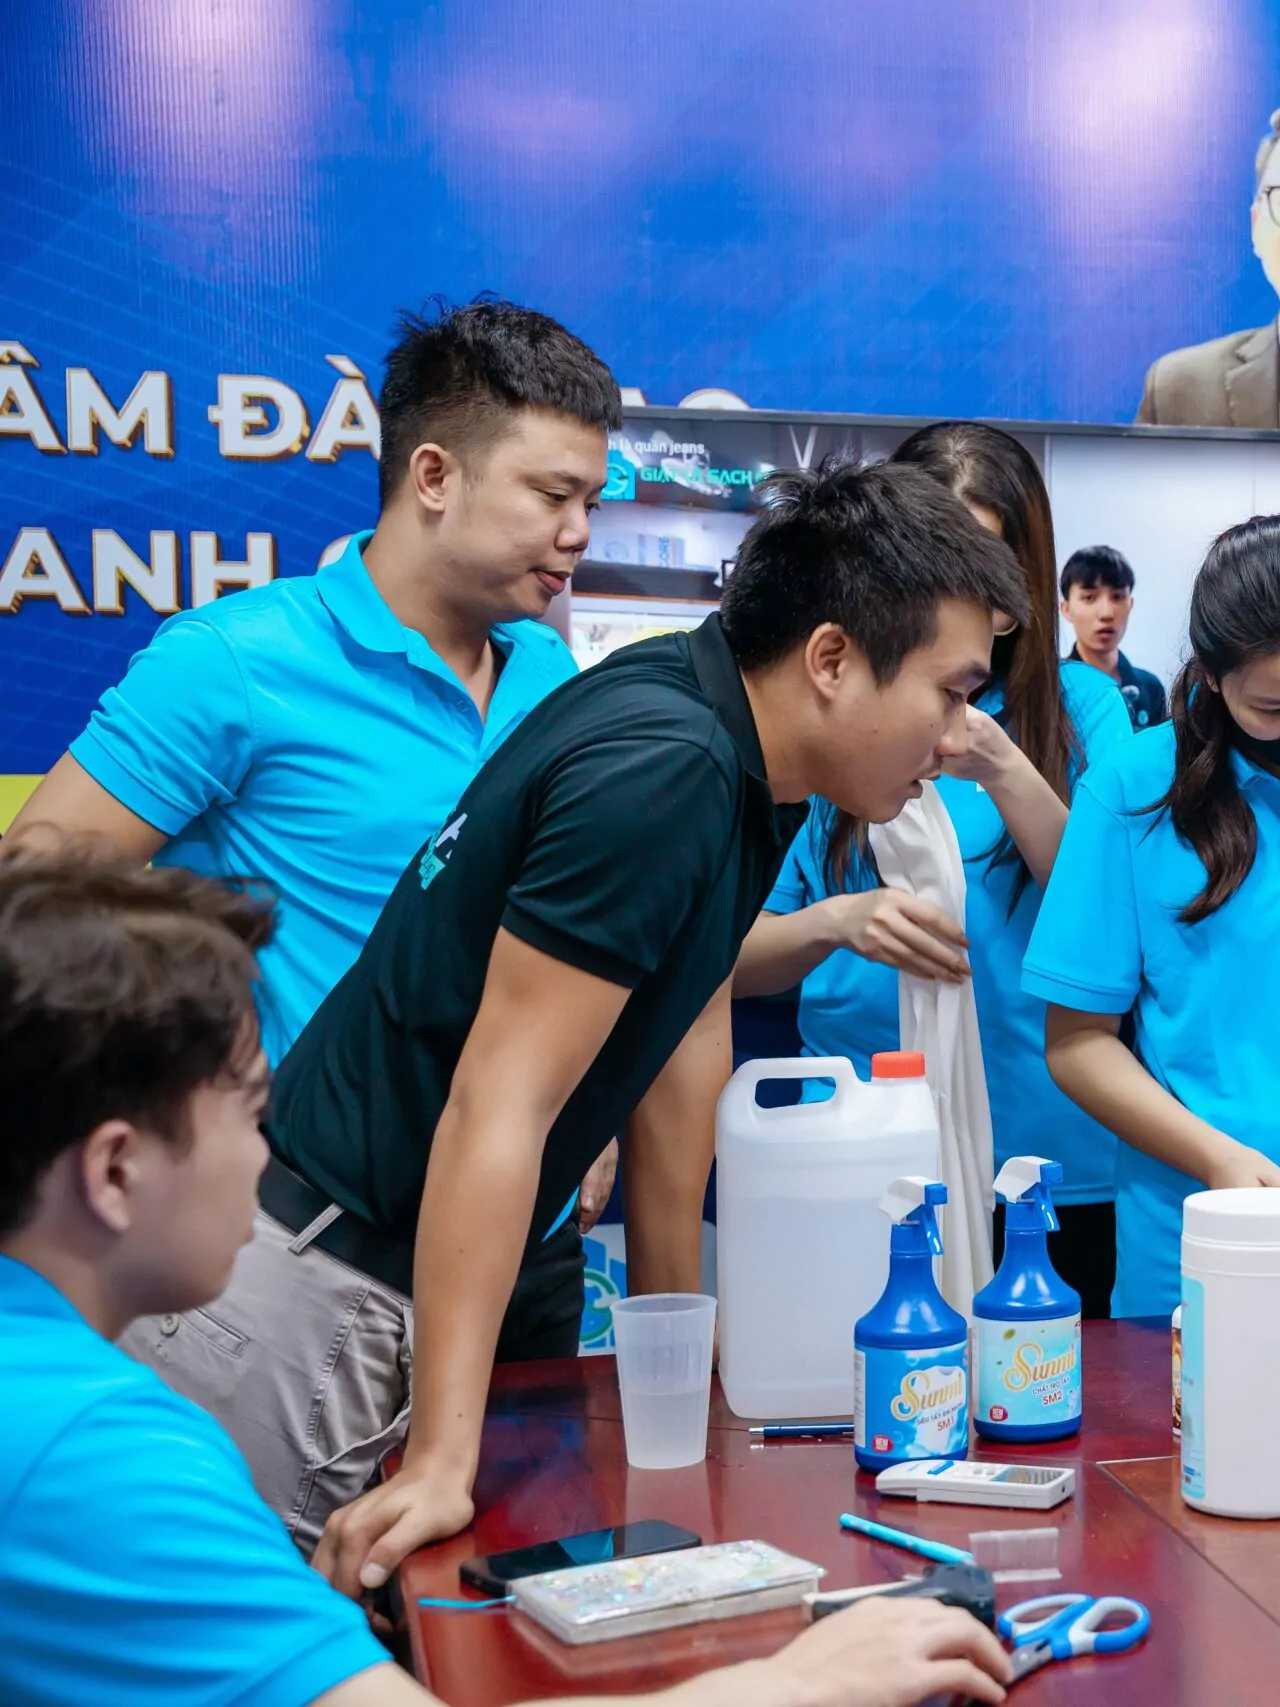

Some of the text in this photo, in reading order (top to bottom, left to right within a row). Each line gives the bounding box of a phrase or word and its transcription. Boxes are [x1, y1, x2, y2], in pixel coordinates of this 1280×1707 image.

[668, 440, 705, 456] jeans
[1004, 1342, 1075, 1391] Sunmi
[1043, 1391, 1063, 1406] SM2
